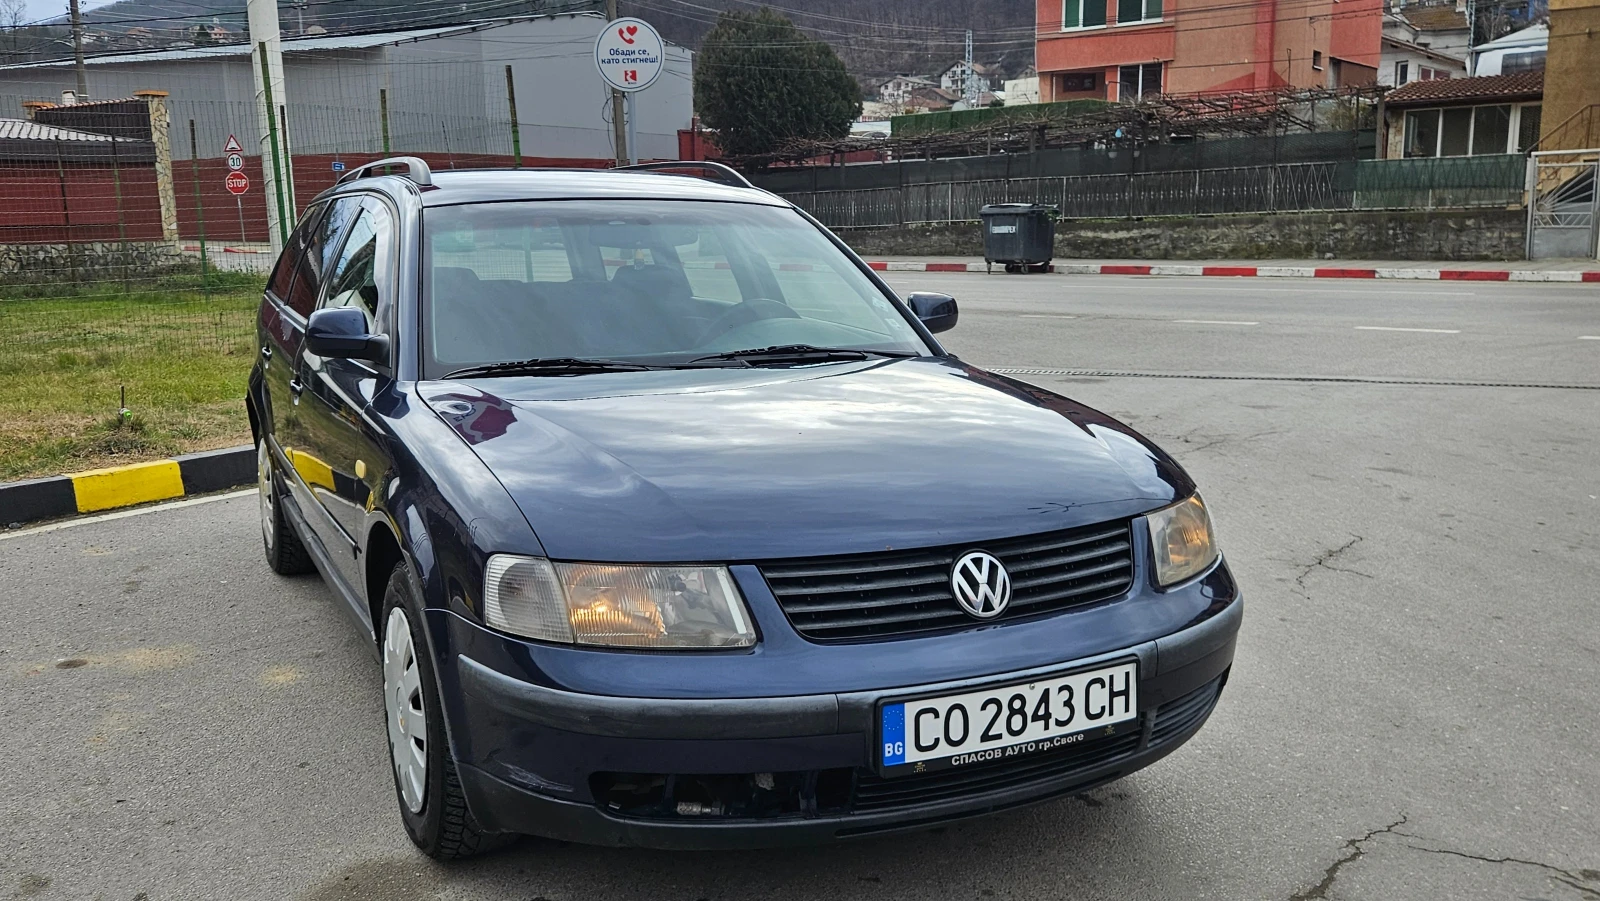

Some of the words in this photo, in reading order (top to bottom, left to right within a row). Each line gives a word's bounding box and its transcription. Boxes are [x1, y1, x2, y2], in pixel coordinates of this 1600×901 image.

[609, 48, 636, 57] Обади
[637, 48, 650, 56] се,
[622, 55, 659, 64] стигнеш!
[230, 157, 241, 167] 30
[228, 178, 247, 188] STOP
[914, 703, 970, 752] CO
[980, 684, 1075, 743] 2843
[1084, 671, 1131, 721] CH
[884, 742, 904, 757] BG
[951, 749, 1003, 766] СПАСОВ
[1005, 742, 1036, 757] АУТО
